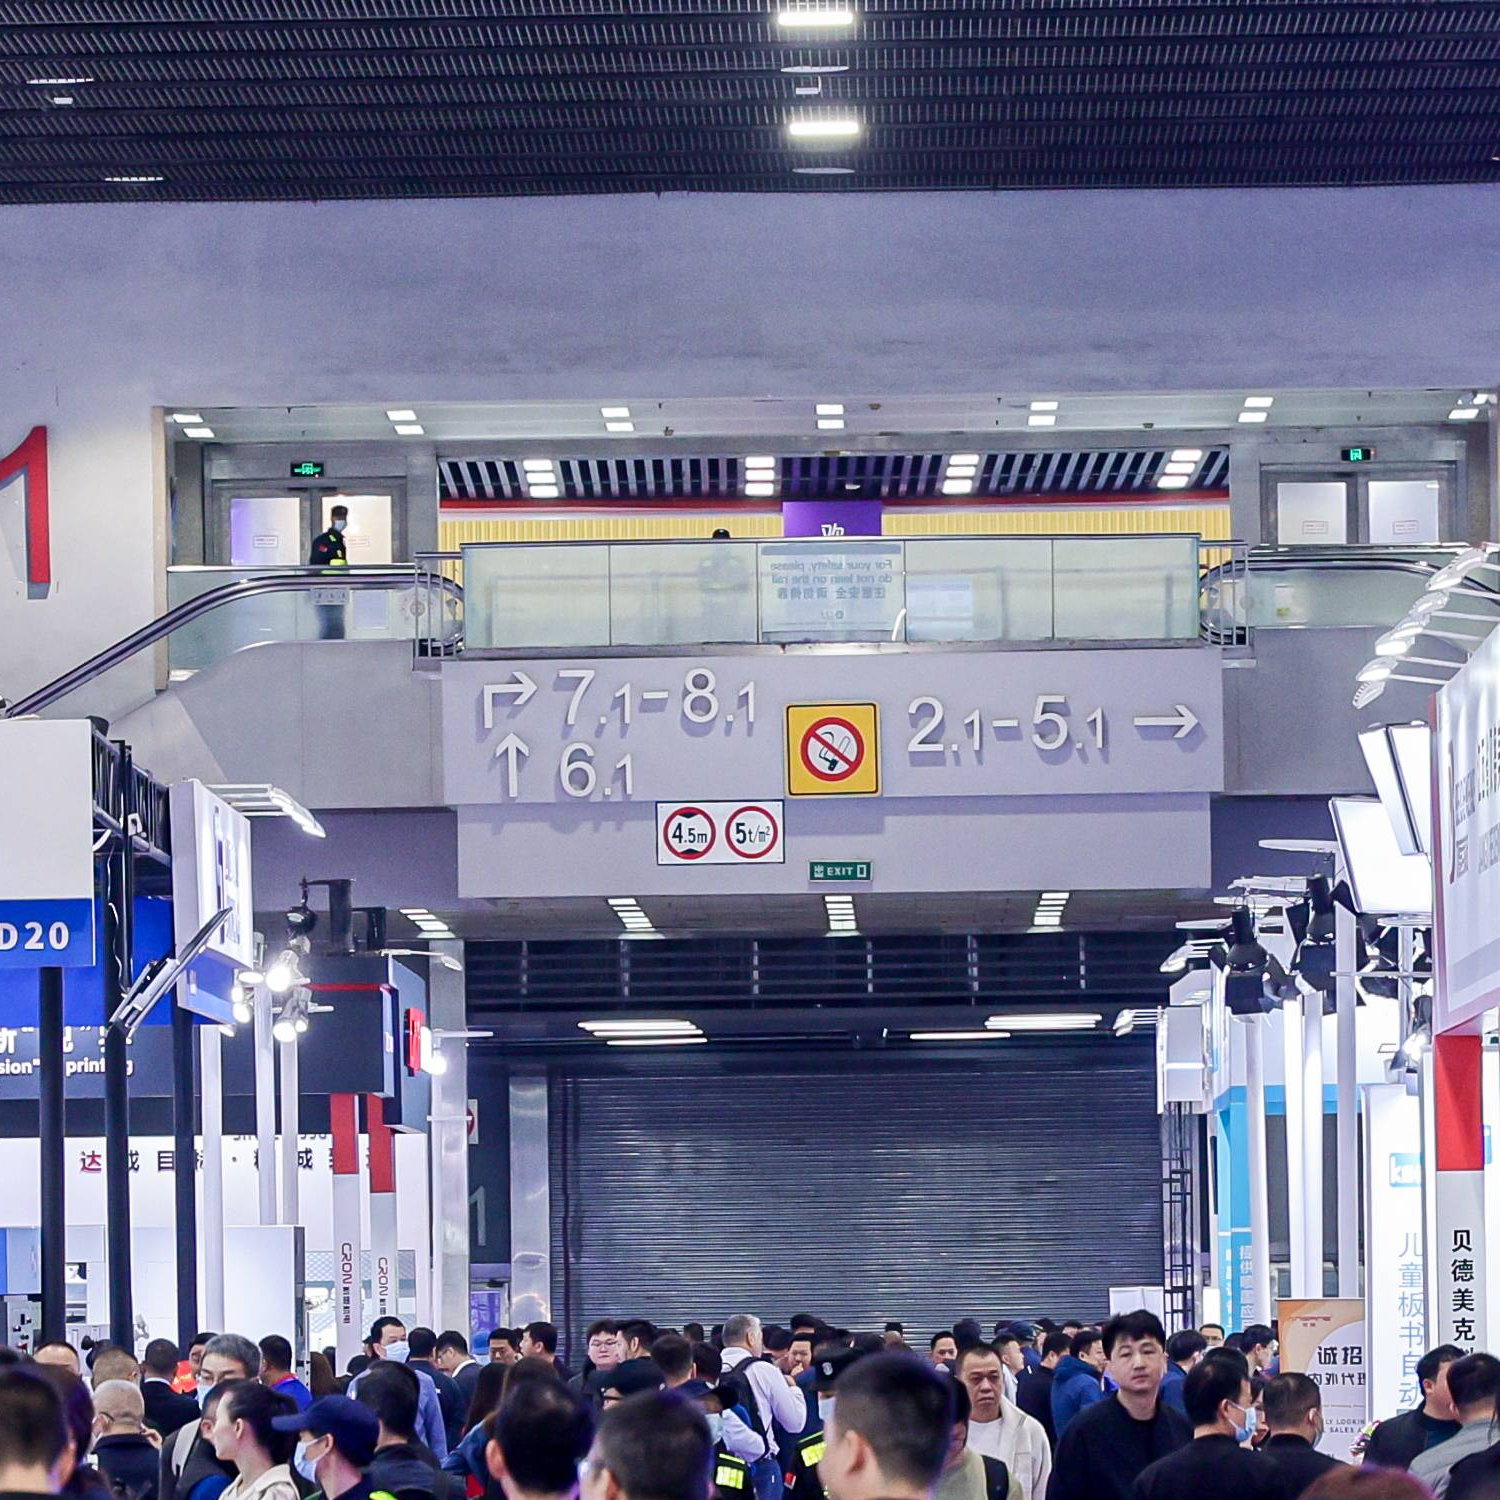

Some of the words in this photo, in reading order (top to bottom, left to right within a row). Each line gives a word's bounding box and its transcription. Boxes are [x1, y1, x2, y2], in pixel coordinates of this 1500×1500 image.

[558, 667, 758, 727] 7.1-8.1
[907, 697, 1105, 754] 2.1-5.1
[560, 743, 634, 799] 6.1
[671, 821, 708, 845] 4.5m
[826, 866, 854, 876] EXIT
[1451, 1229, 1476, 1355] 贝德美克
